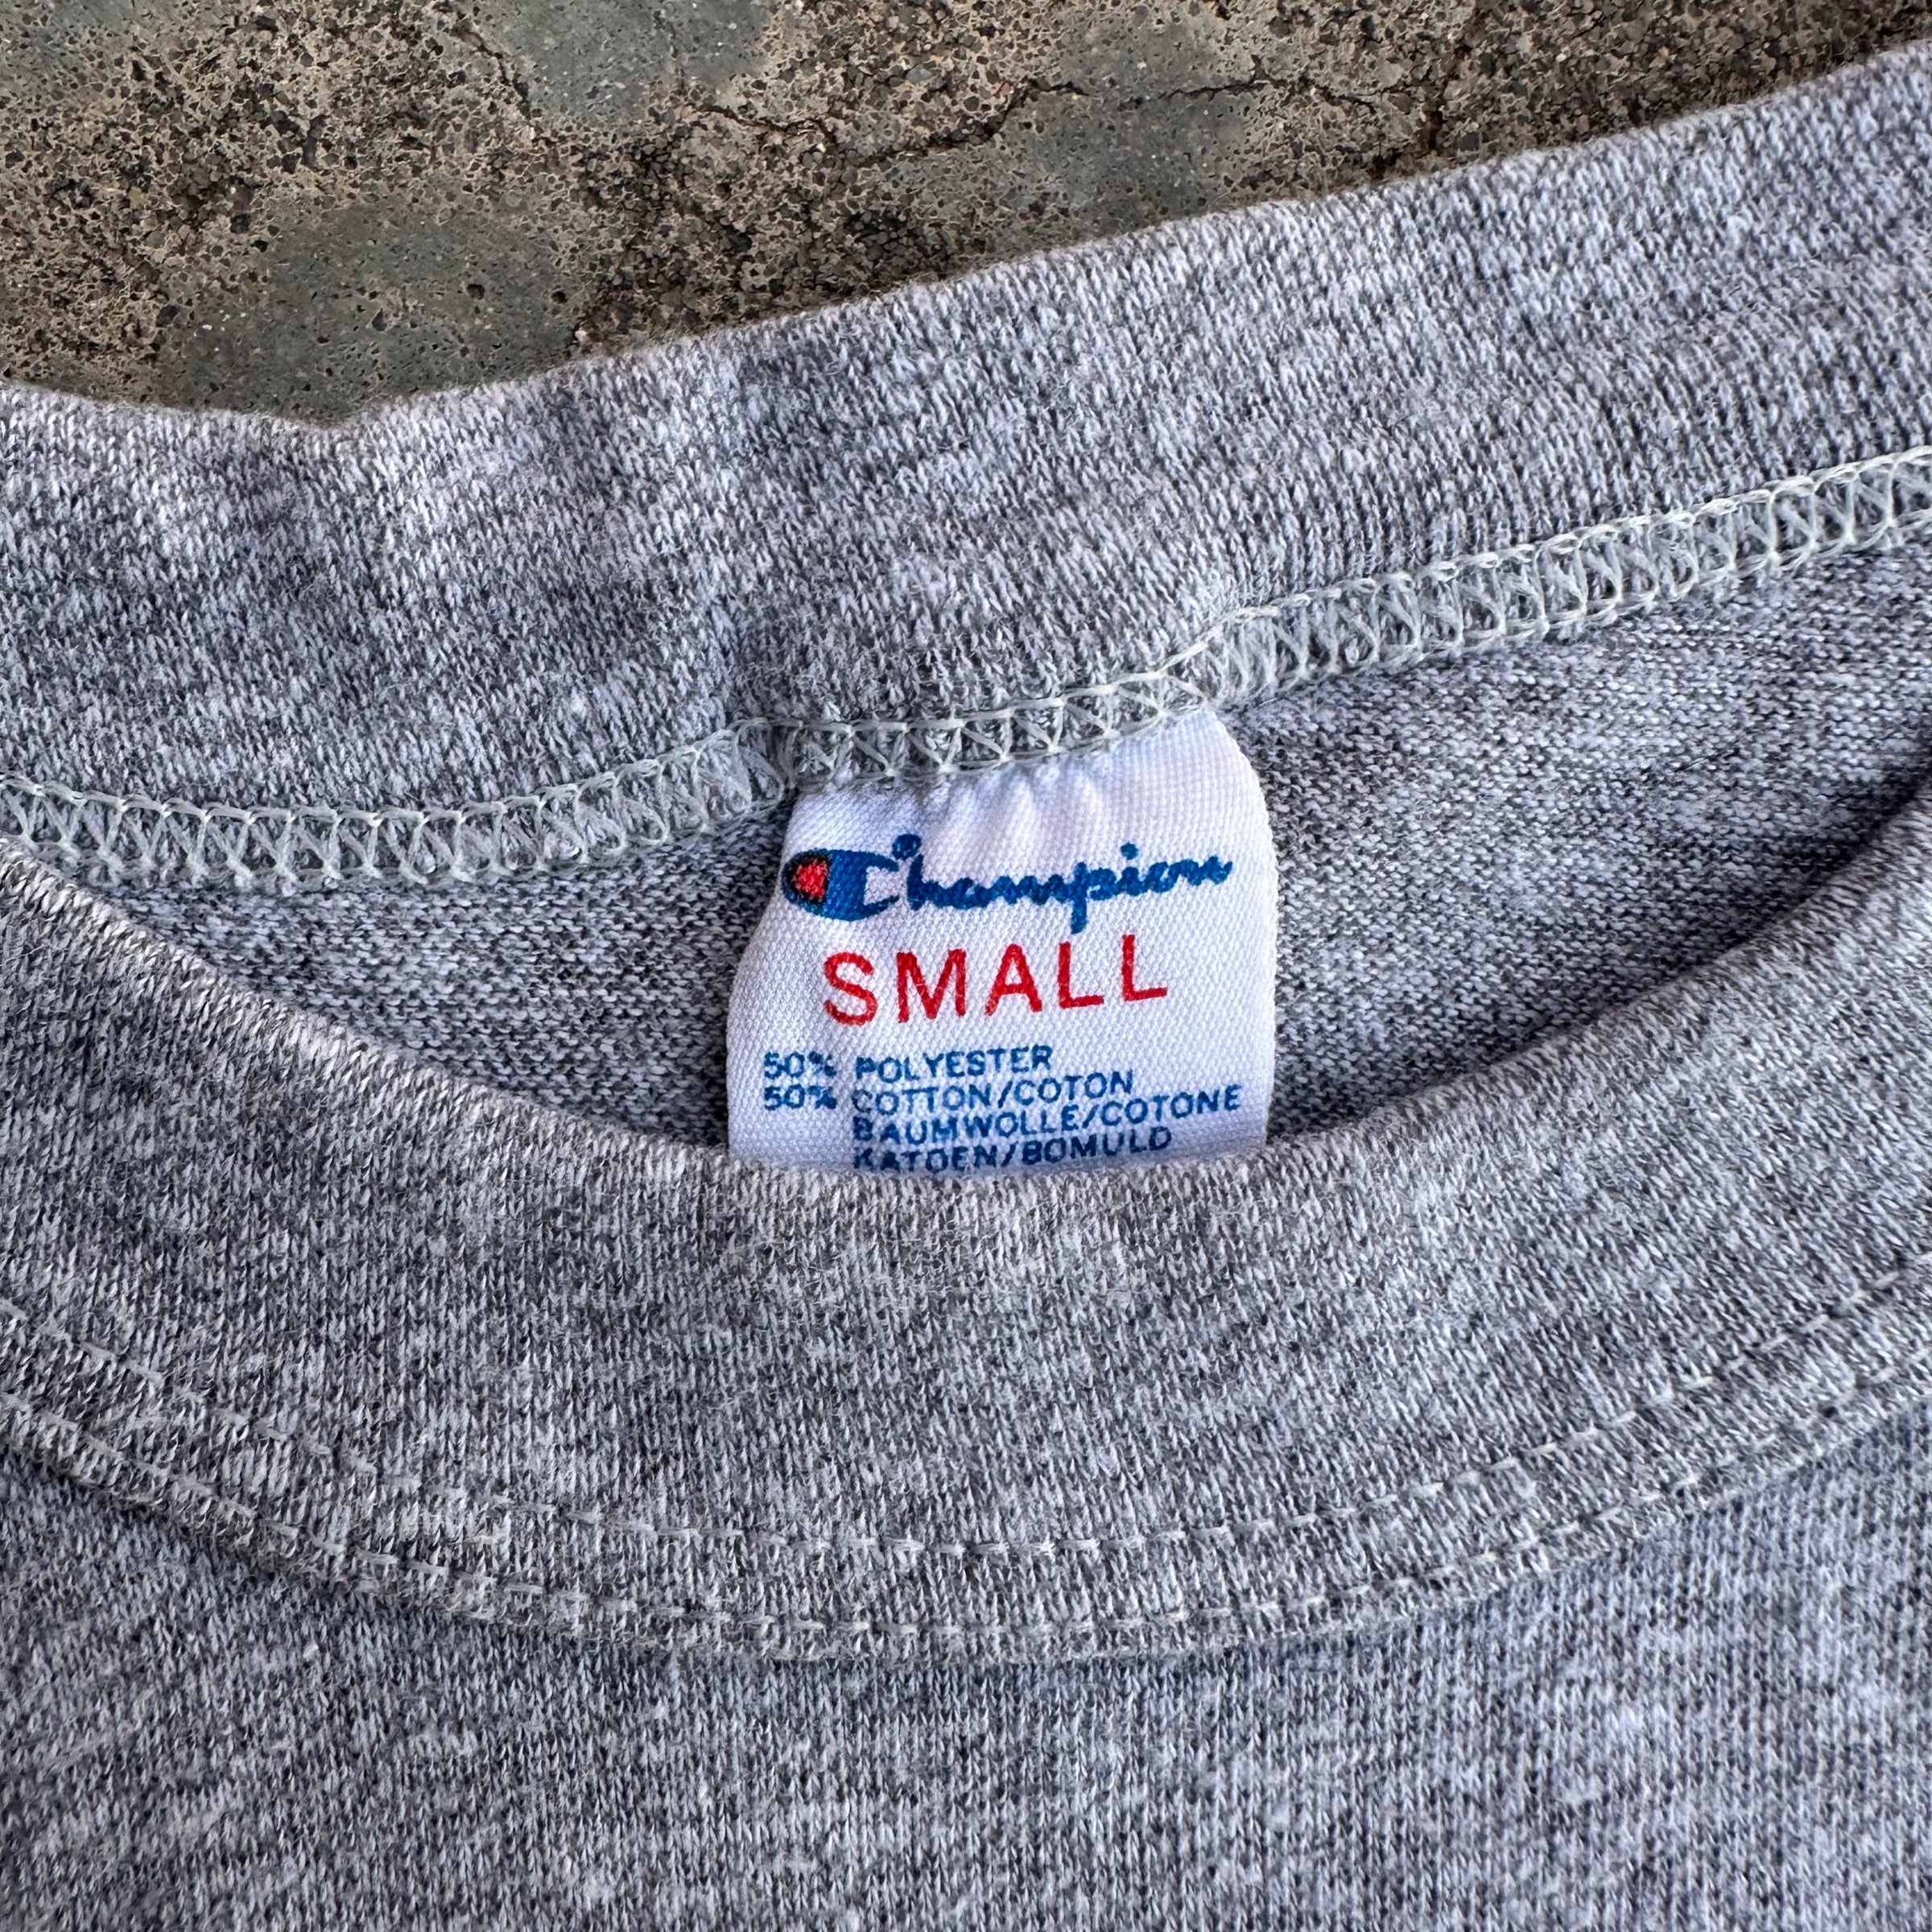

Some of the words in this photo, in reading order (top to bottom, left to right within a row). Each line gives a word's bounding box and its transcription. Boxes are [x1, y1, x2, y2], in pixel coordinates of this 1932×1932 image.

[782, 834, 1233, 934] Champion
[823, 934, 1168, 1026] SMALL
[764, 1050, 837, 1080] 50%
[855, 1044, 1054, 1084] POLYESTER
[764, 1084, 838, 1111] 50%
[851, 1069, 1133, 1116] COTTON/COTON
[852, 1084, 1241, 1145] BAUMWOLLE/COTONE
[853, 1126, 1171, 1174] KATOEN/BOMULD
